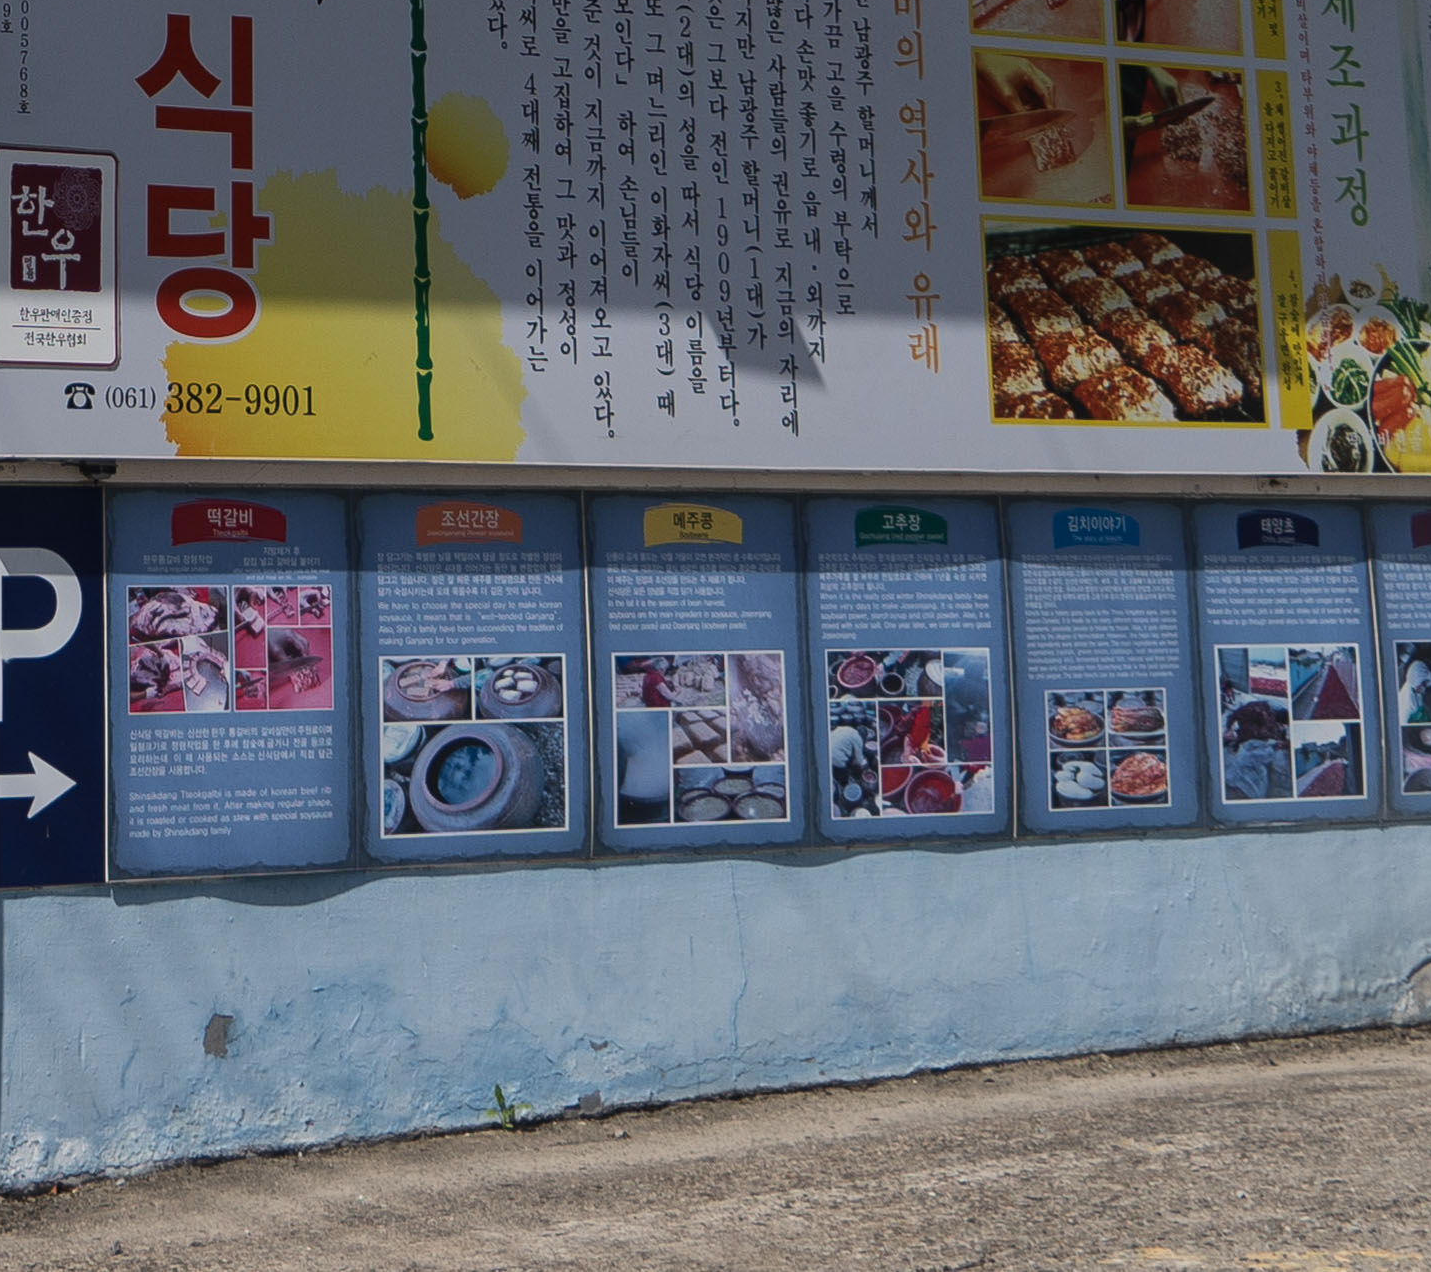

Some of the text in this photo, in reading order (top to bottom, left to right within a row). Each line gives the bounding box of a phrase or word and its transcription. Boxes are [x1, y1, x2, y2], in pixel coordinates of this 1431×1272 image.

[853, 18, 874, 96] 남광주
[521, 72, 540, 154] 4대째
[857, 106, 879, 239] 할머니께서
[899, 99, 937, 252] 역사와
[523, 164, 544, 249] 전통을
[12, 185, 81, 290] 한우
[19, 307, 93, 324] 한우판매인증점
[525, 257, 549, 373] 이어가는
[906, 272, 941, 374] 유래
[24, 331, 87, 348] 전국한우협회
[105, 382, 317, 416] (061) 382-9901
[207, 508, 253, 528] 떡갈비
[441, 510, 499, 529] 조선간장
[673, 511, 713, 530] 메주콩
[883, 513, 921, 531] 고추장
[1067, 515, 1126, 532] 김치이야기
[1261, 517, 1295, 534] 태양초
